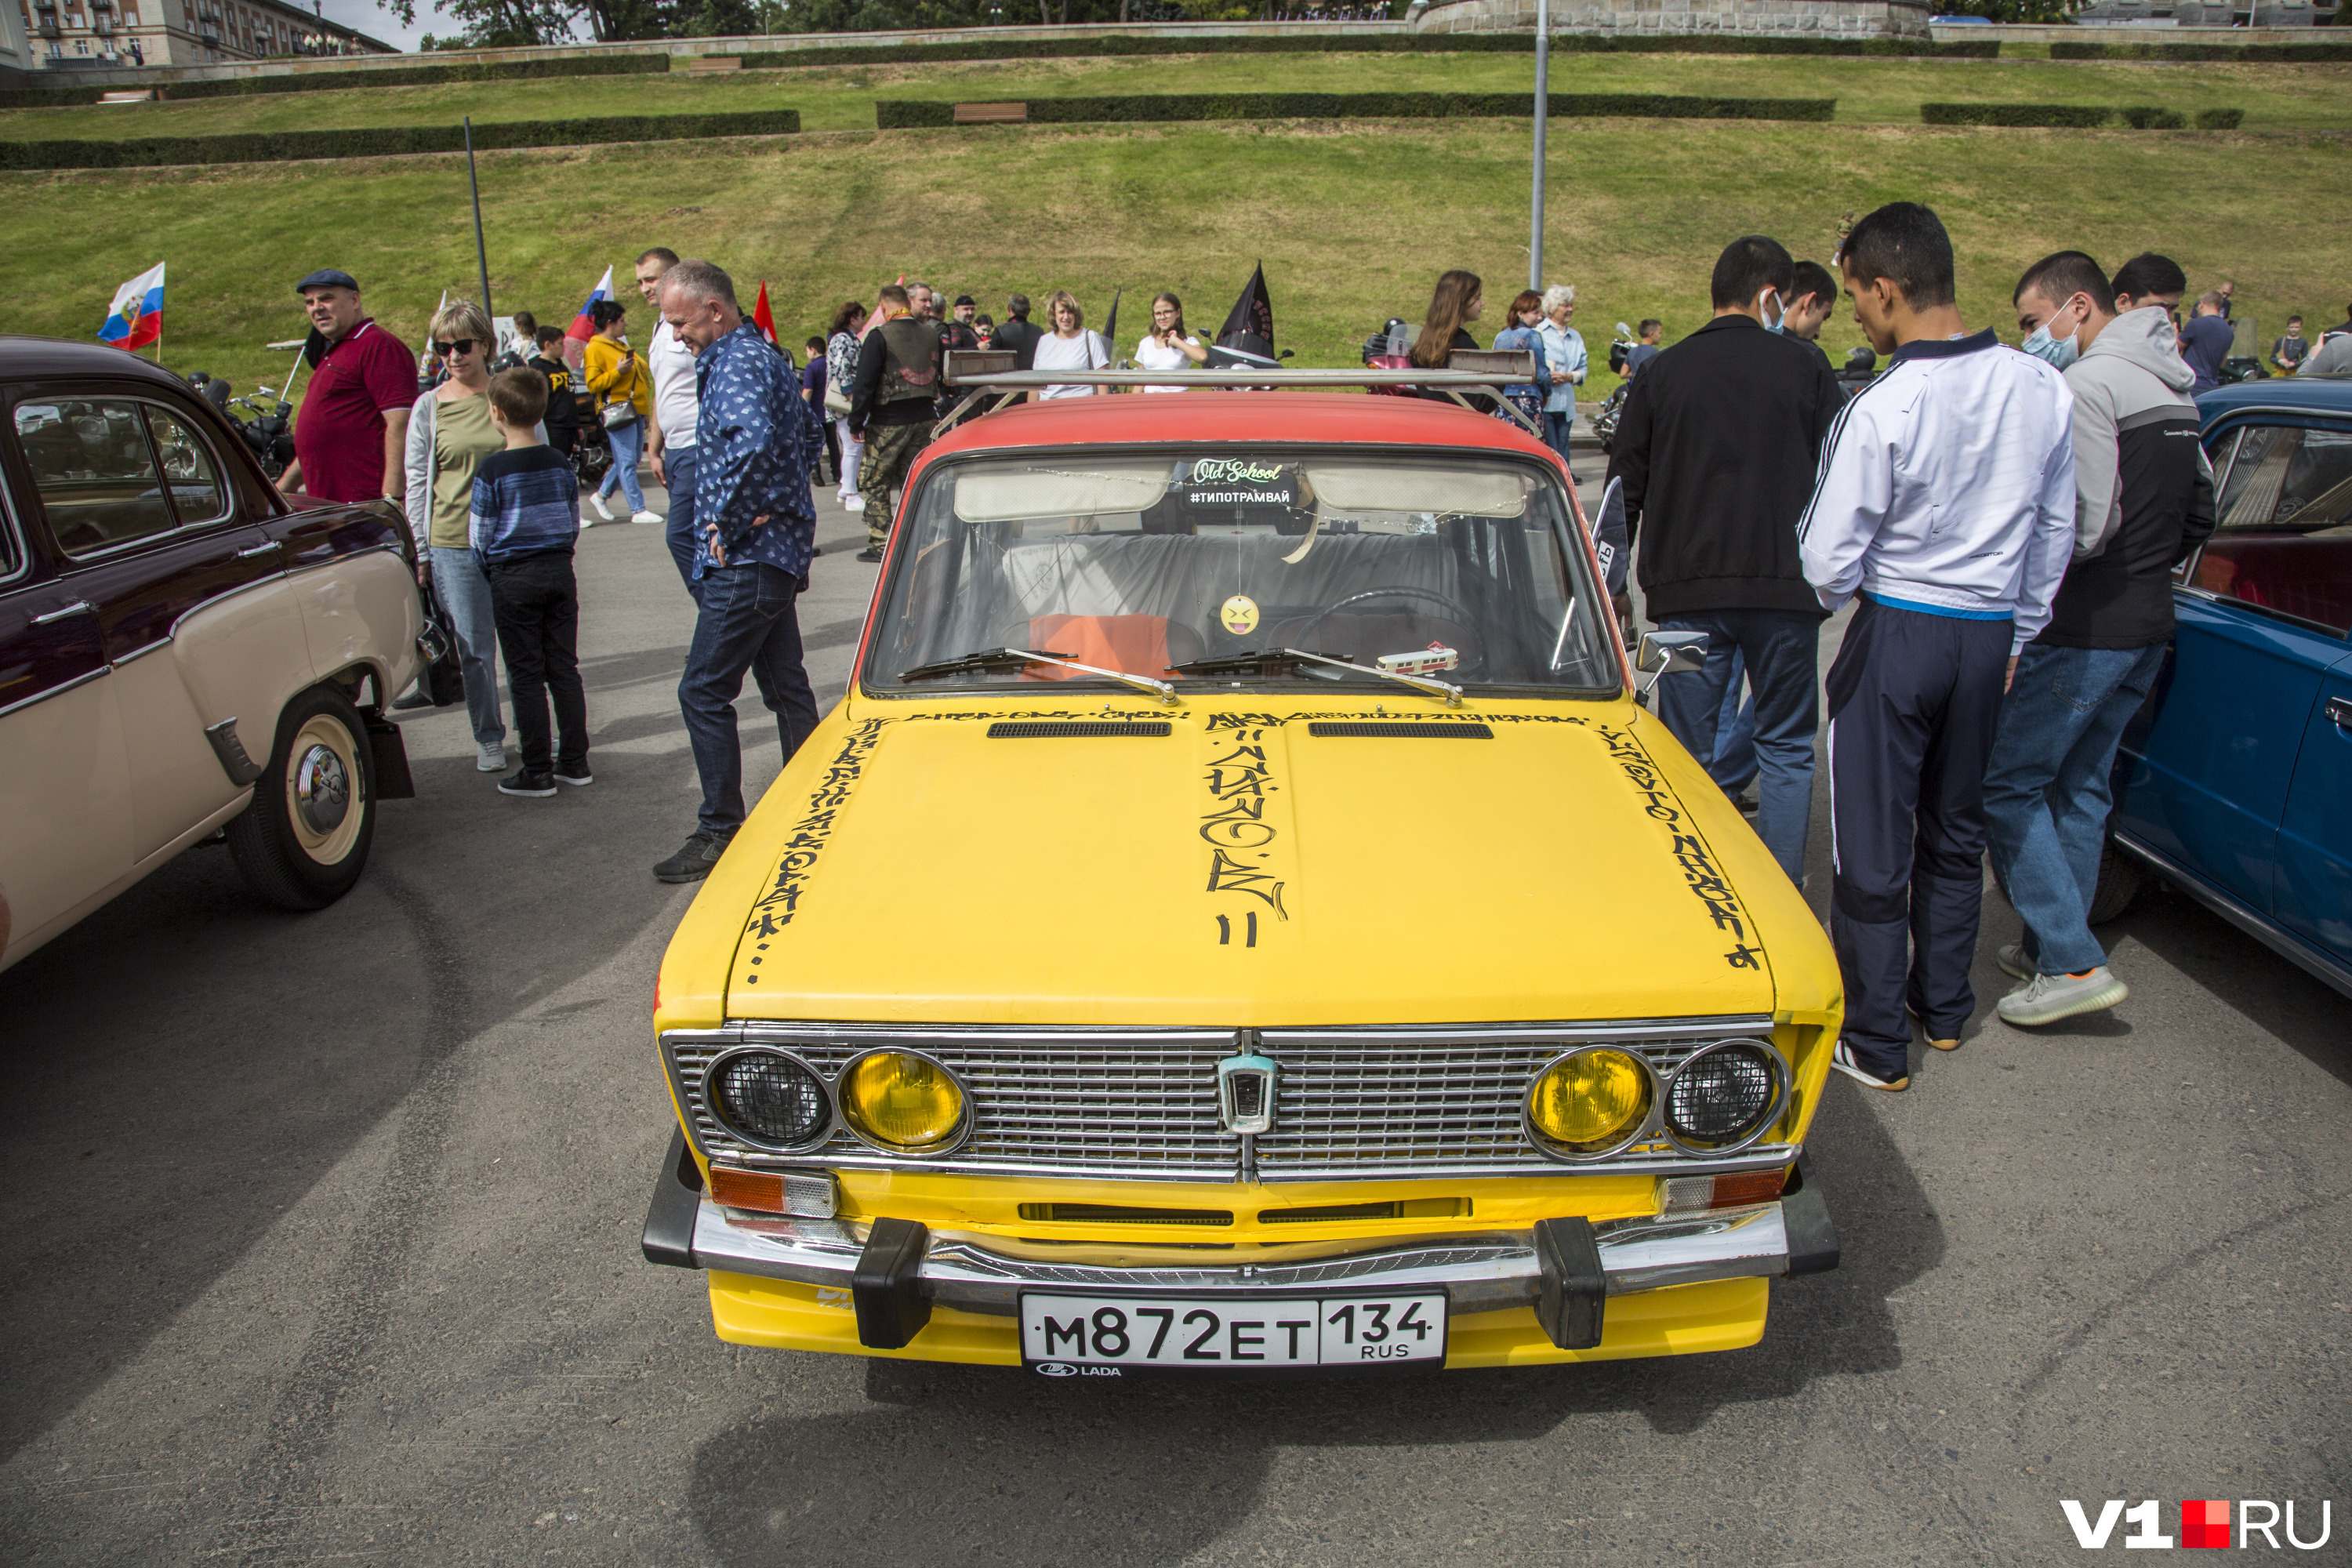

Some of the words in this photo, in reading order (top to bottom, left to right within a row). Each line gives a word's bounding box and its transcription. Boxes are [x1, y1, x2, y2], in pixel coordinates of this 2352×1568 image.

[1194, 458, 1236, 483] Old
[1226, 461, 1283, 483] School
[1190, 490, 1290, 503] #ТИПОТРАМВАЙ
[1327, 1301, 1426, 1344] 134
[1361, 1344, 1409, 1359] RUS
[1081, 1367, 1121, 1376] LADA
